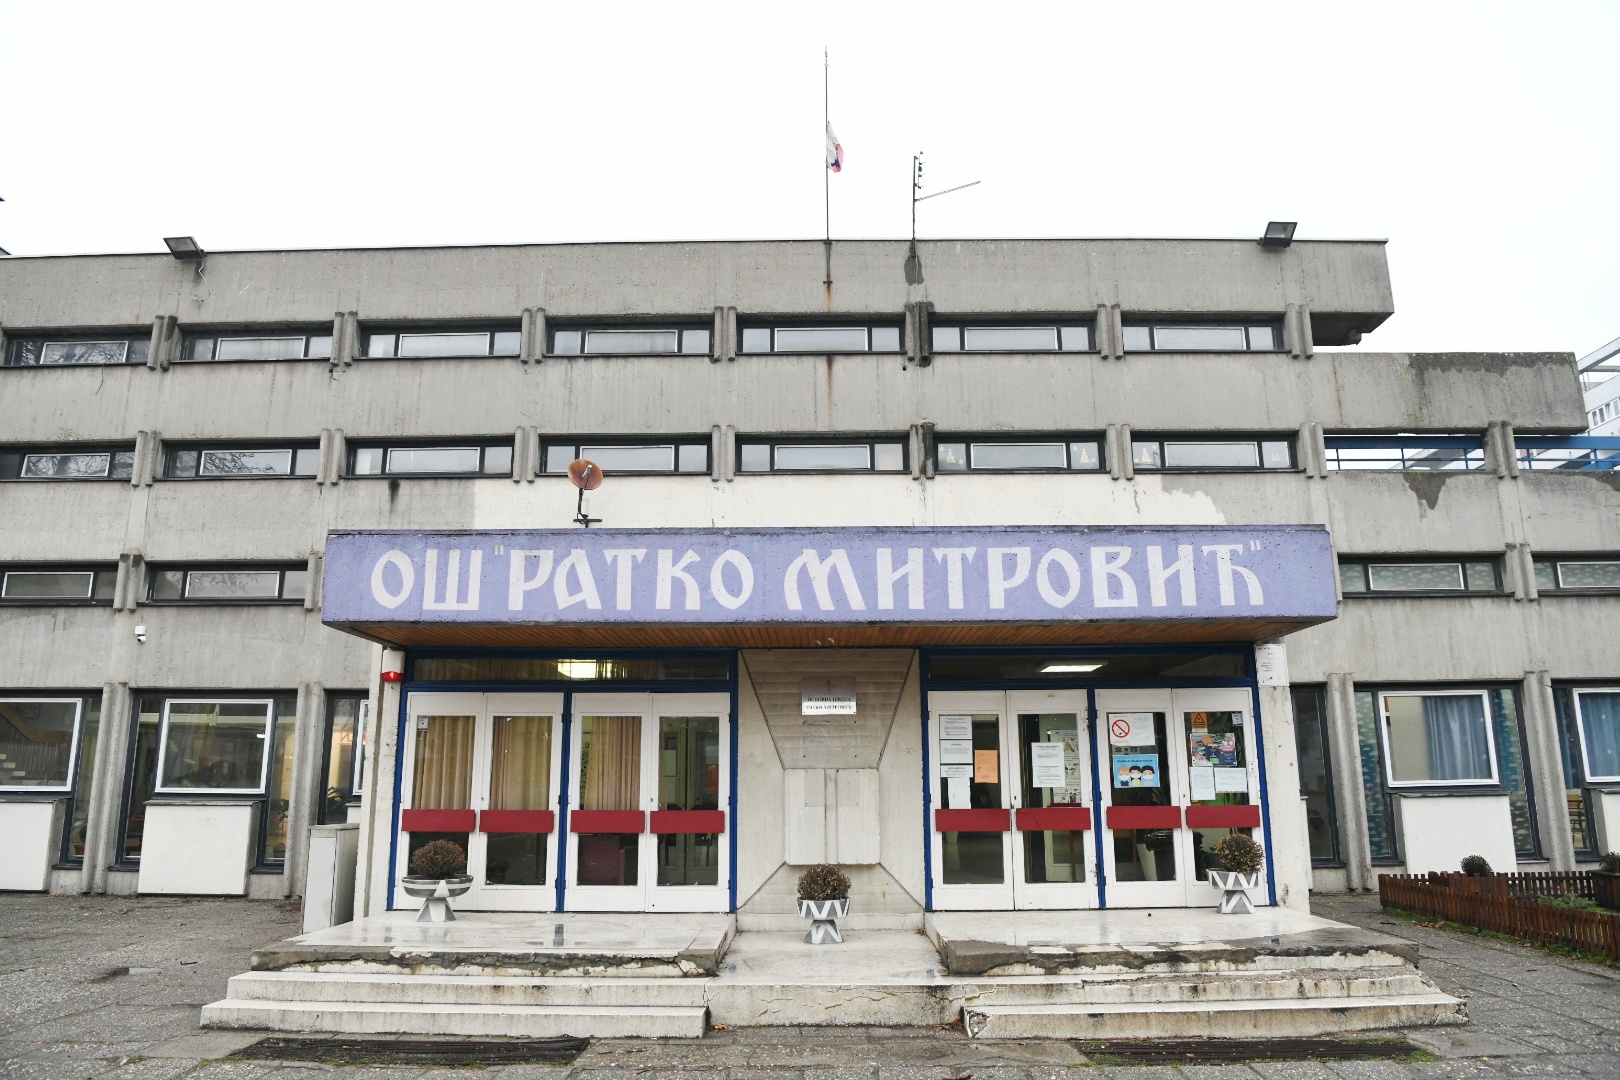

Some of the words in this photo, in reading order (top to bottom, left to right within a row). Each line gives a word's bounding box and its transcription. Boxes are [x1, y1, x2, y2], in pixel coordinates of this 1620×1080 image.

[370, 548, 482, 611] ОШ
[494, 543, 754, 611] "РАТКО
[783, 539, 1265, 611] МИТРОВИЋ"
